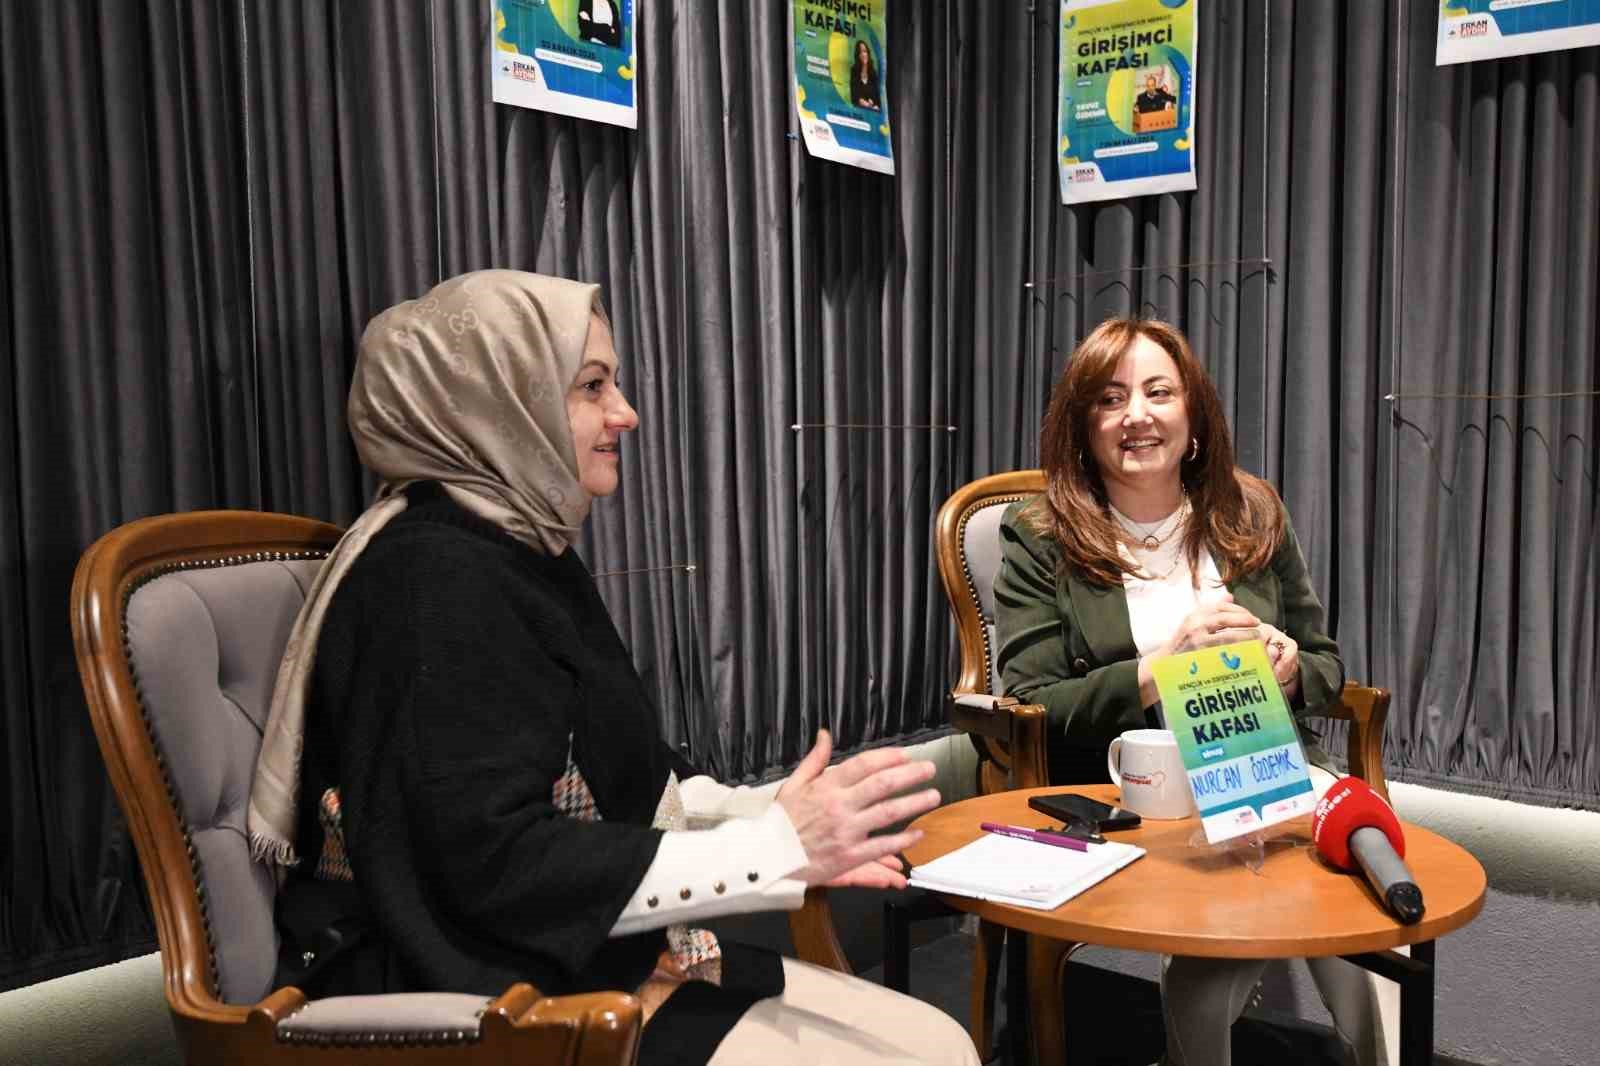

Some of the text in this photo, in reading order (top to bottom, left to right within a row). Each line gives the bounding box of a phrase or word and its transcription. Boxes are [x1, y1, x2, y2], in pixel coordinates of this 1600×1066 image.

[804, 8, 856, 38] KAFASI
[1077, 23, 1172, 57] GİRİŞİMCİ
[1076, 52, 1149, 77] KAFASI
[1185, 679, 1267, 718] GİRİŞİMCİ
[1193, 713, 1261, 744] KAFASI
[1192, 763, 1242, 799] NURCAN
